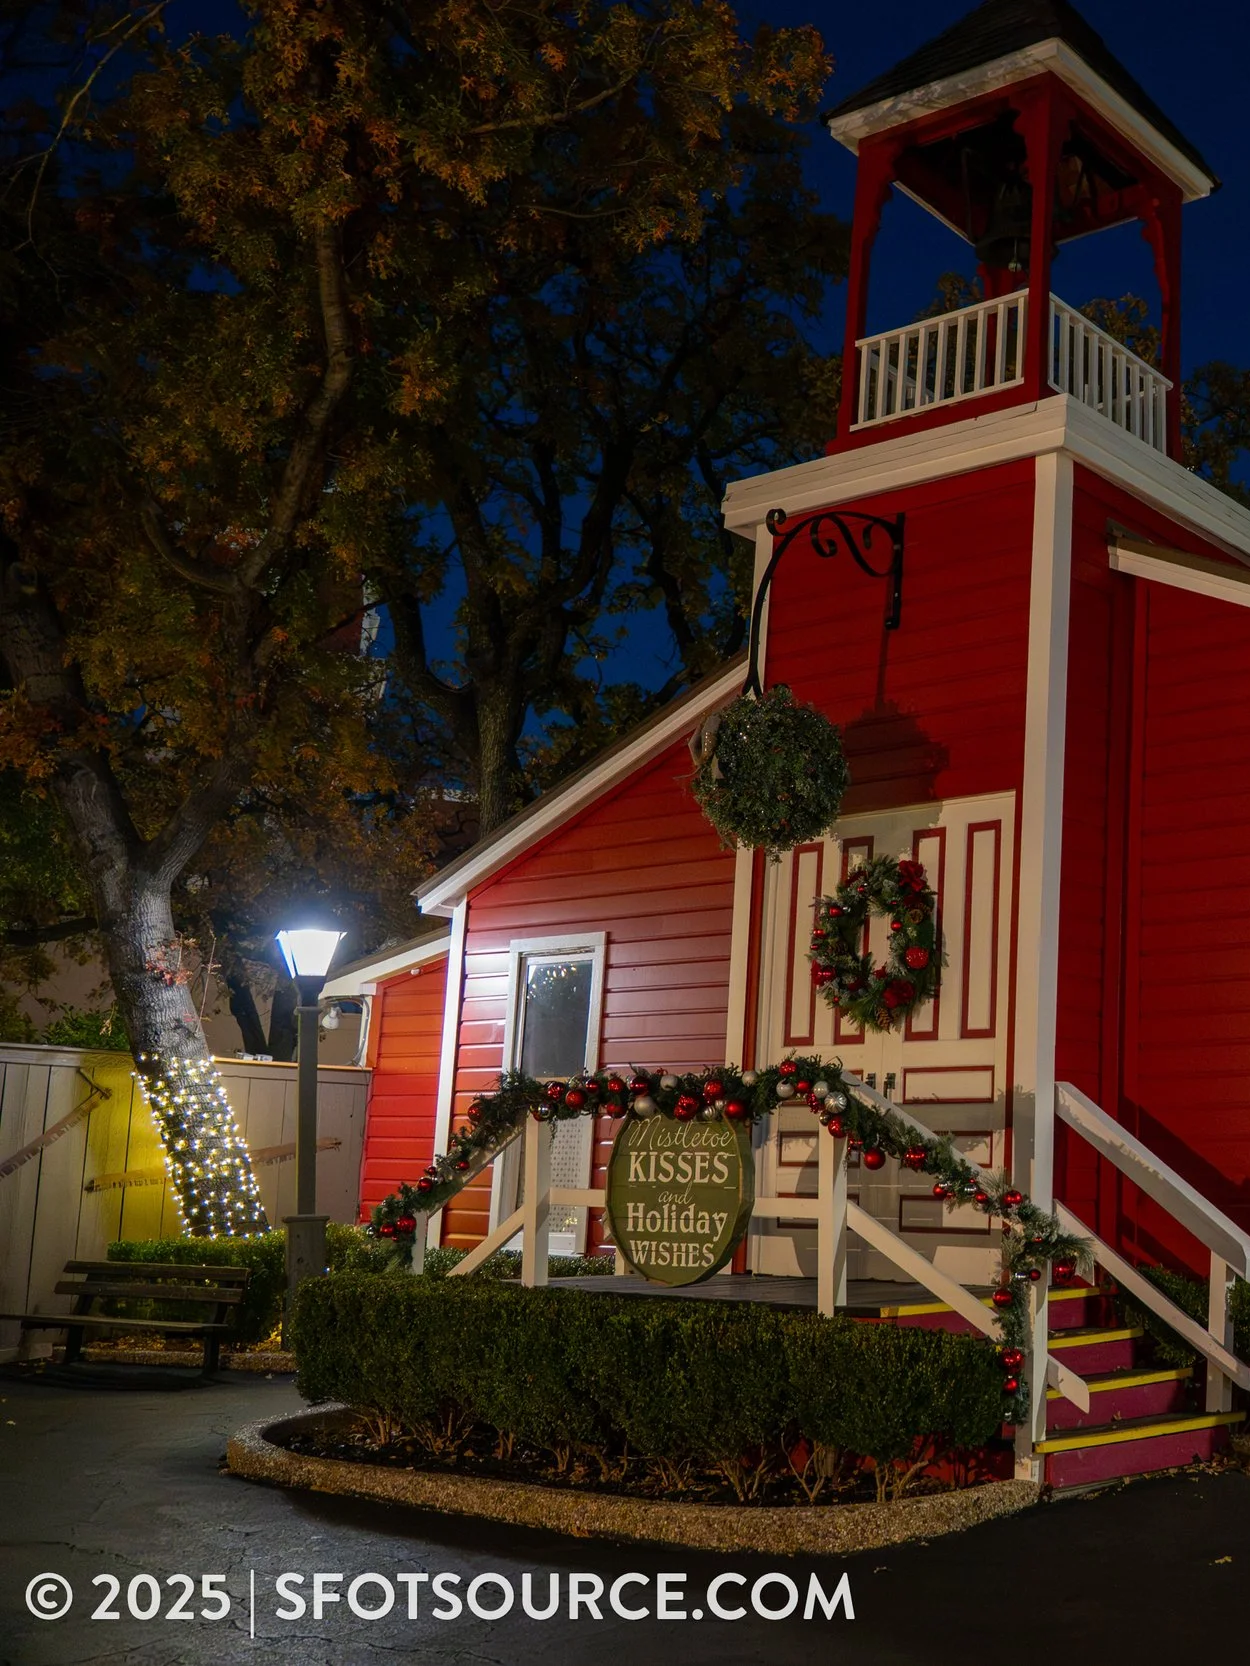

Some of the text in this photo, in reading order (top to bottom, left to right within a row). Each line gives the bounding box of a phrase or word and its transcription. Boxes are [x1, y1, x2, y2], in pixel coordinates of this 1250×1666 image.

[627, 1114, 734, 1151] Mistletoe
[628, 1151, 729, 1184] KISSES
[658, 1184, 693, 1205] and
[626, 1202, 729, 1241] Holiday
[629, 1239, 715, 1267] WISHES
